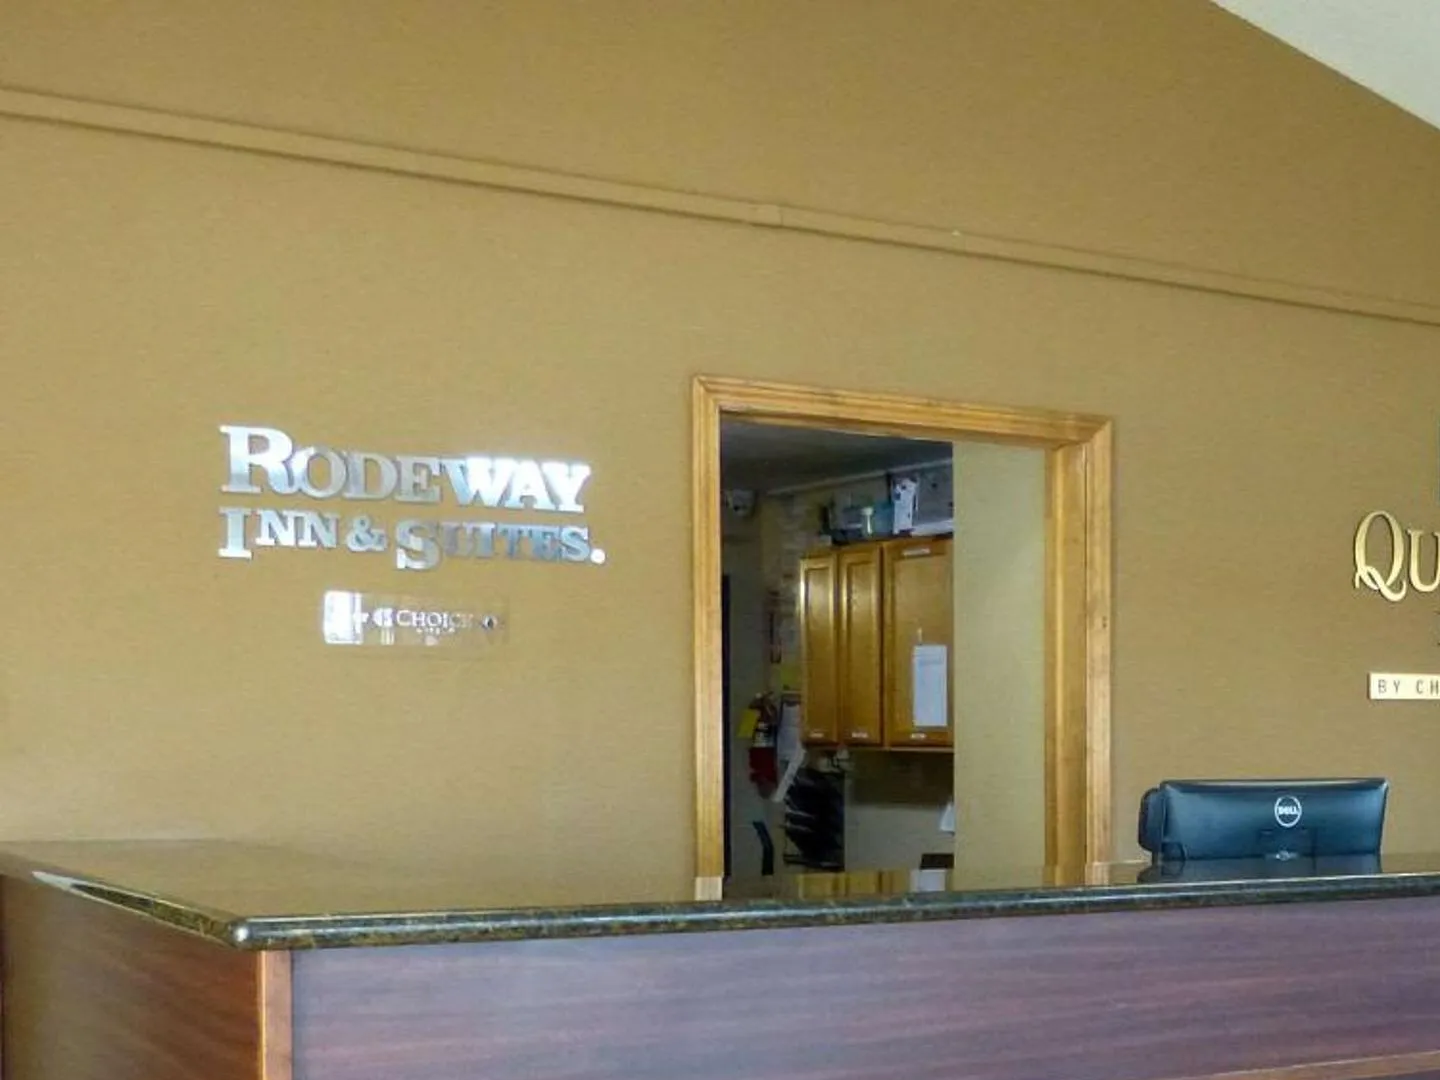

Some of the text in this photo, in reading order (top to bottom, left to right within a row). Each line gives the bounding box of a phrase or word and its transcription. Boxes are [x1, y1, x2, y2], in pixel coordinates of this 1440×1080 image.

[219, 424, 592, 513] RODEWAY
[218, 507, 338, 560] INN
[345, 515, 387, 553] &
[1377, 679, 1401, 695] BY
[1278, 806, 1298, 815] DELL
